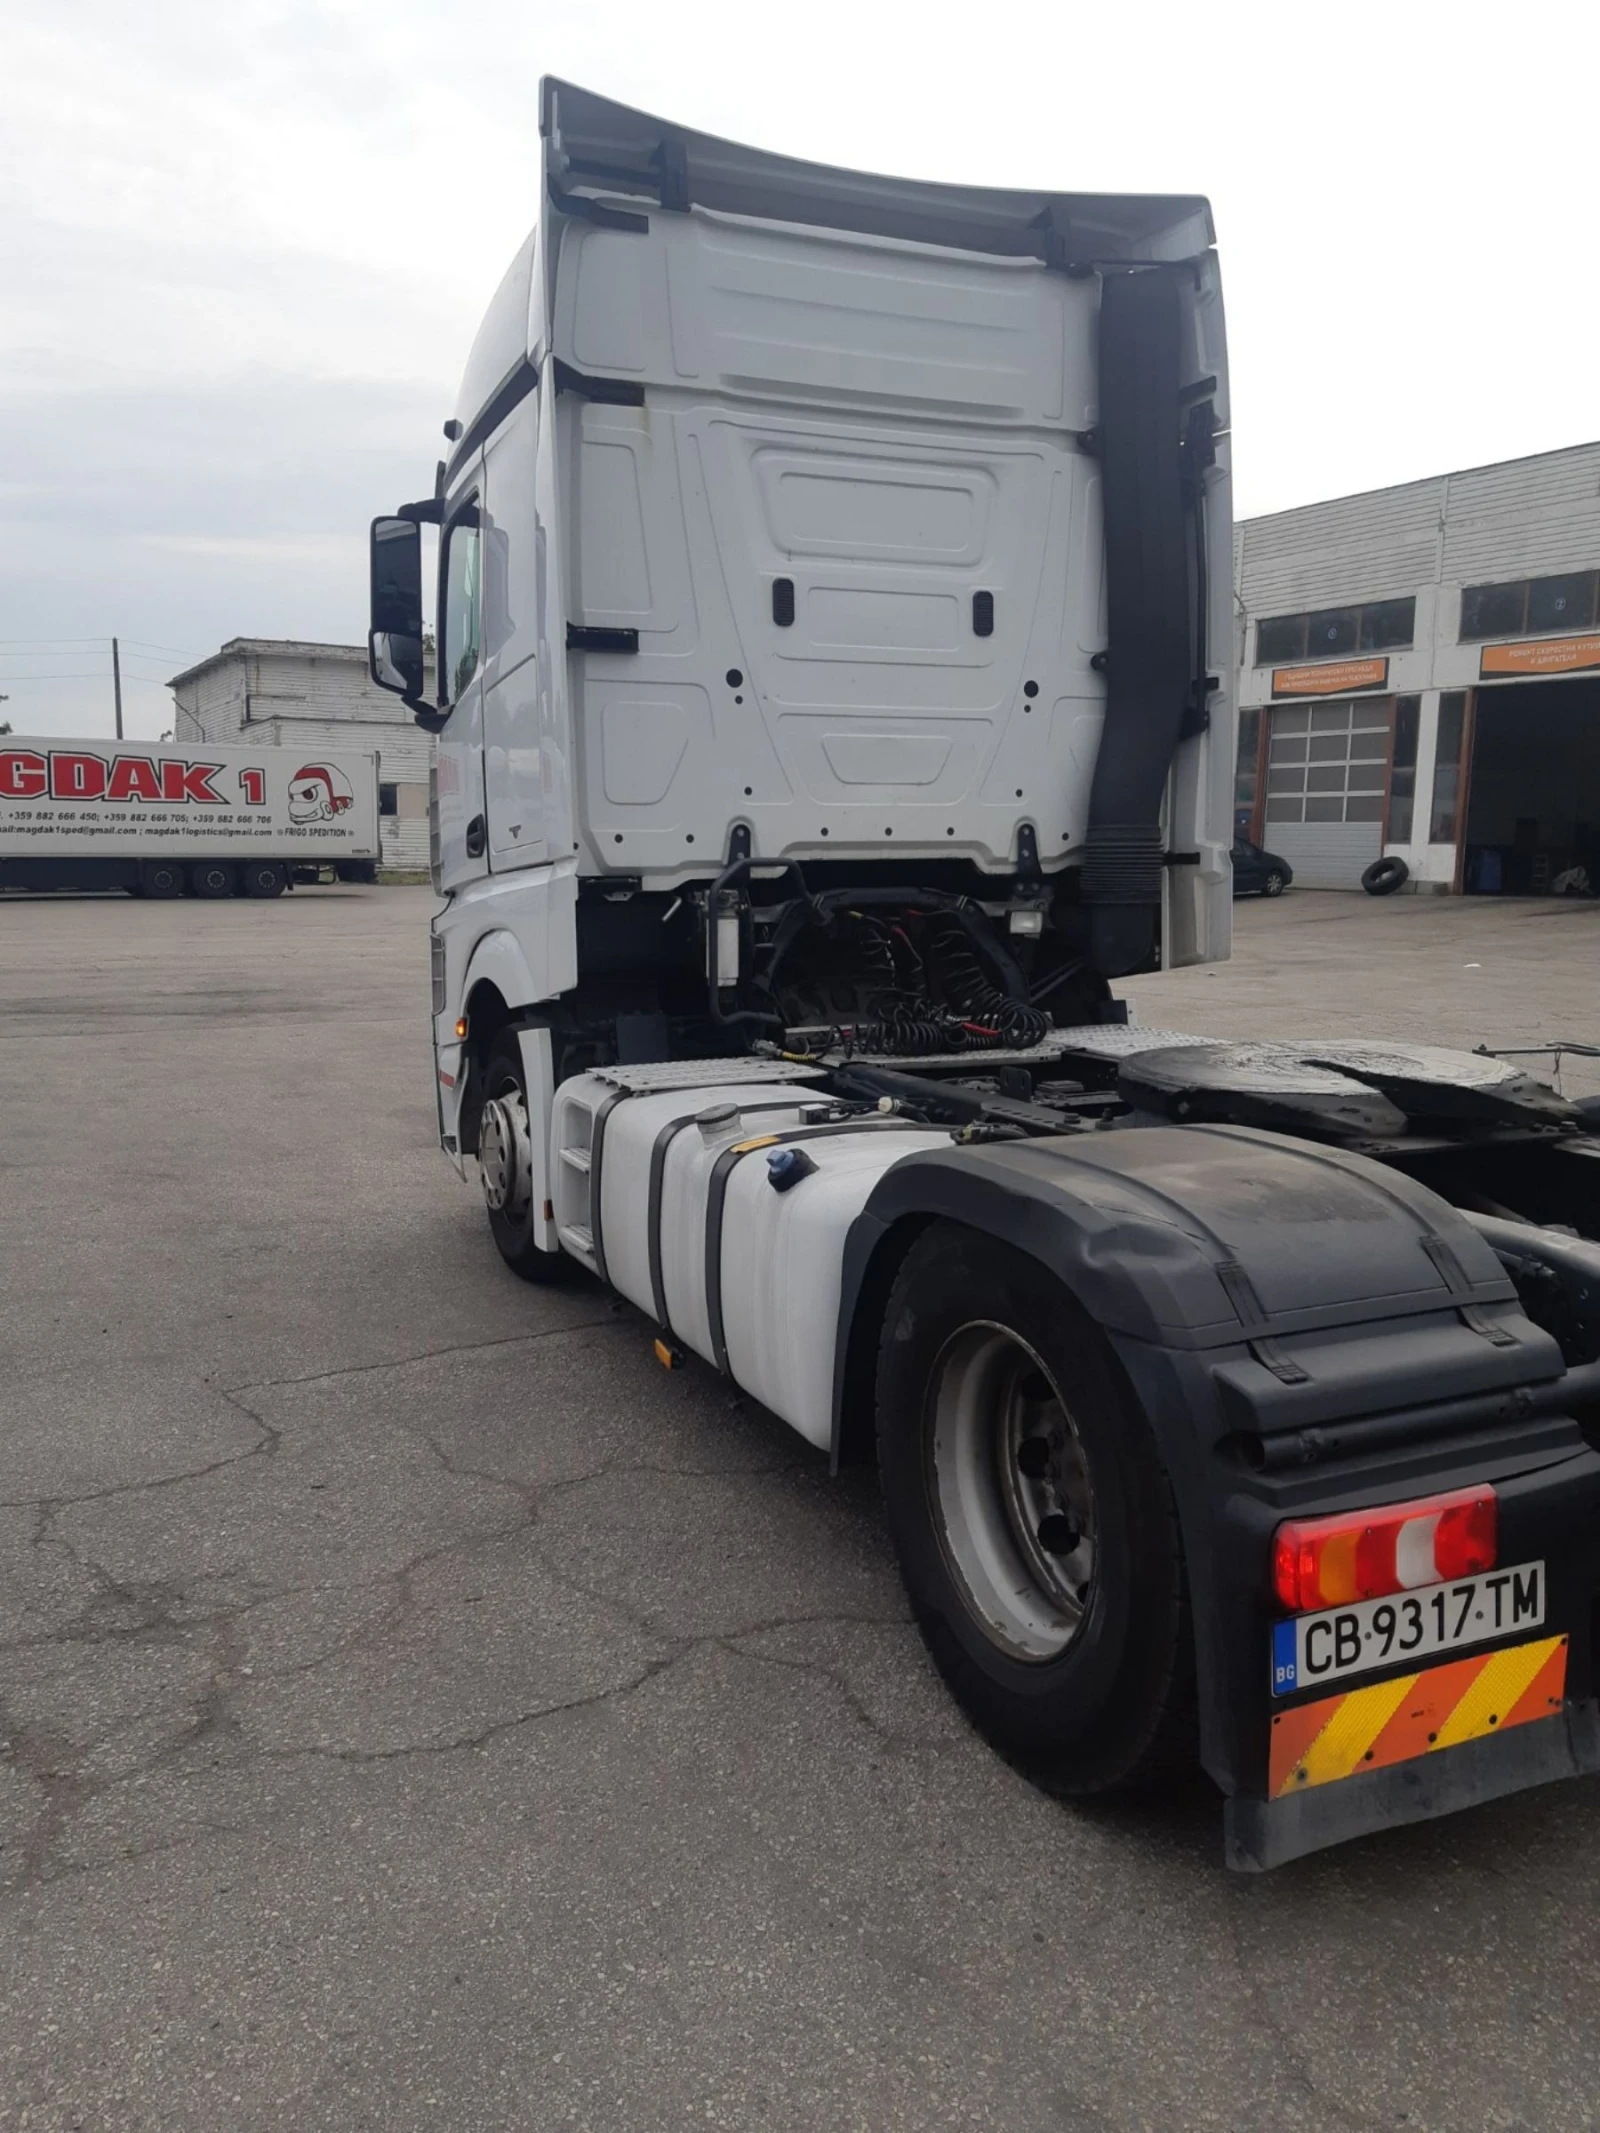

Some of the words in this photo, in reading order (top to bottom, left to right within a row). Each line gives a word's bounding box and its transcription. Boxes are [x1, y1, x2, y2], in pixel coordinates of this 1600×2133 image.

[239, 768, 266, 805] 1
[9, 811, 32, 820] +359
[36, 811, 54, 820] 882
[58, 812, 76, 821] 666
[104, 813, 126, 822] +359
[130, 813, 147, 822] 882
[151, 814, 167, 822] 666
[193, 814, 214, 823] +359
[257, 815, 272, 824] 706
[284, 827, 307, 837] FRIGO
[309, 827, 346, 838] SPEDITION
[1305, 1613, 1362, 1675] CB
[1371, 1583, 1476, 1658] 9317
[1486, 1568, 1539, 1629] TM
[1276, 1664, 1295, 1684] BG
